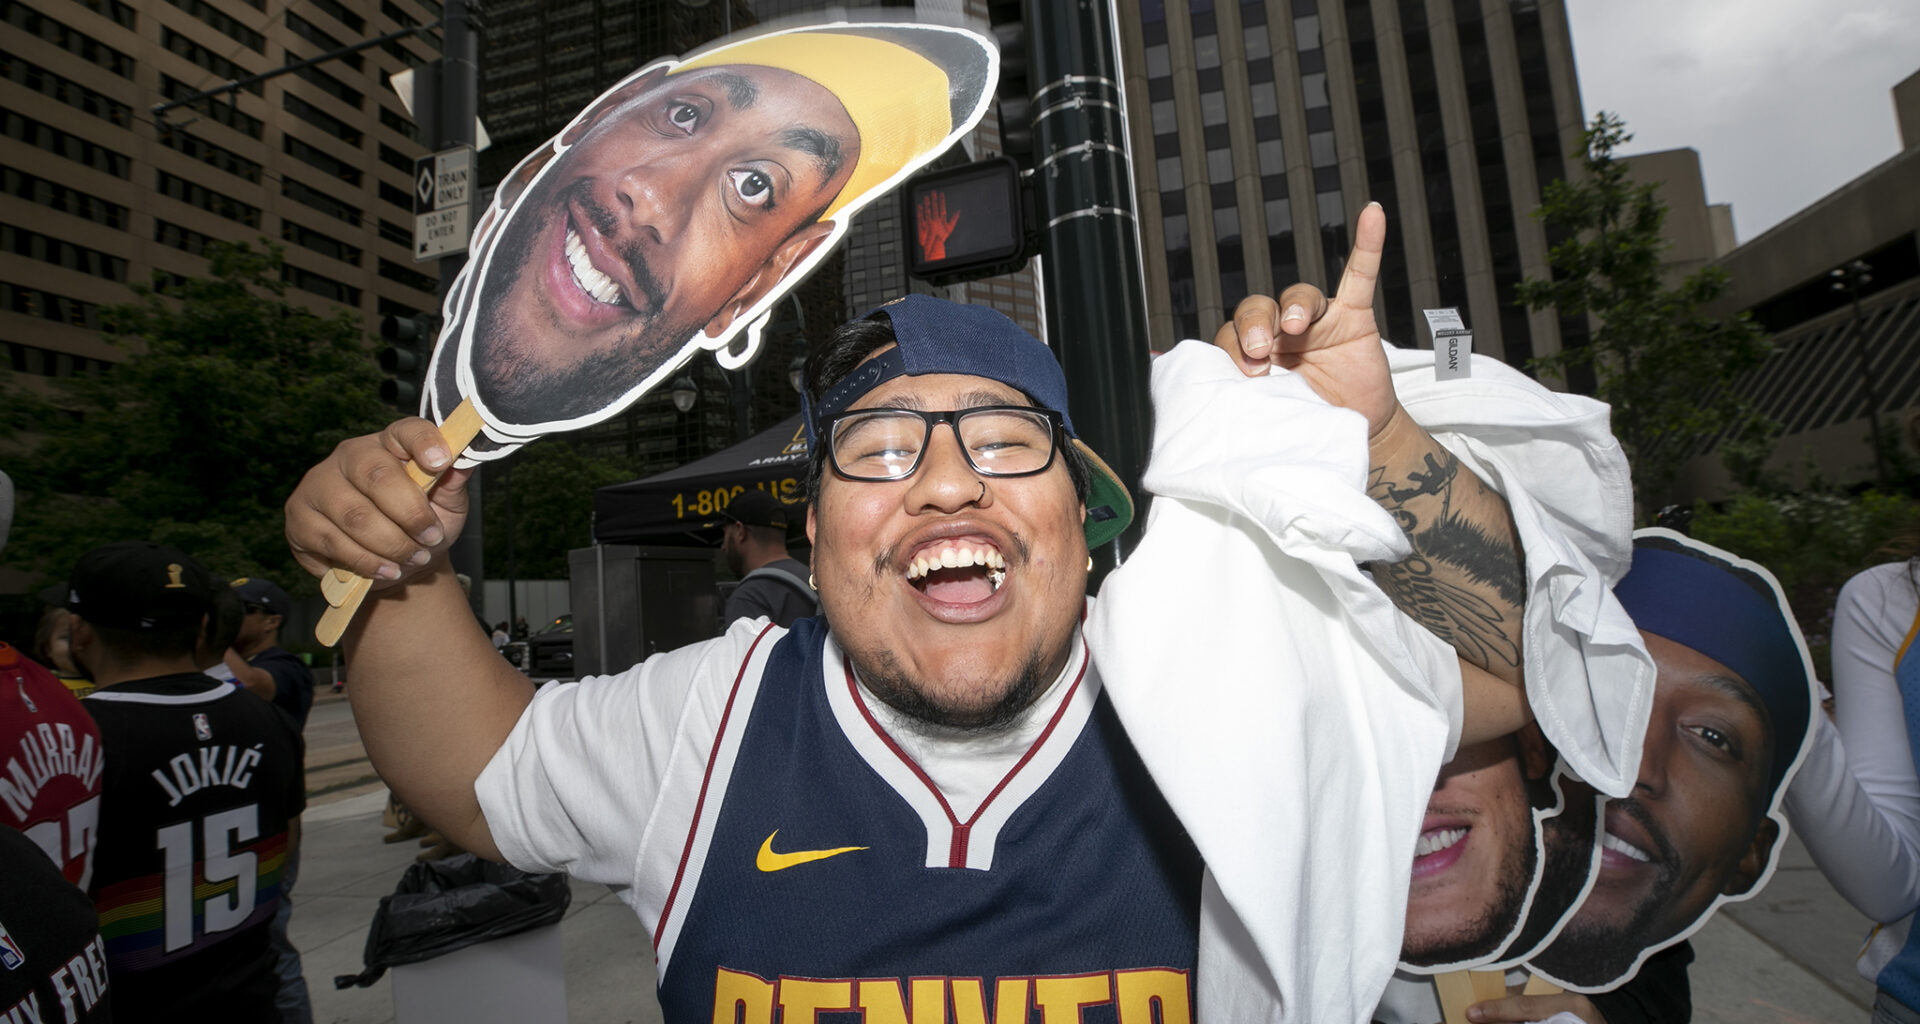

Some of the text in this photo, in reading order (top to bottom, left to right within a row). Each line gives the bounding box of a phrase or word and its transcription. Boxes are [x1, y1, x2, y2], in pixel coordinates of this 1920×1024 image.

[438, 168, 467, 187] TRAIN
[438, 184, 464, 203] ONLY
[425, 210, 458, 228] DO NOT
[428, 224, 455, 240] ENTER
[1448, 337, 1458, 370] GILDAN
[748, 453, 802, 467] ARMY
[151, 742, 265, 808] JOKIĆ
[22, 795, 101, 894] 7
[156, 803, 261, 954] 15
